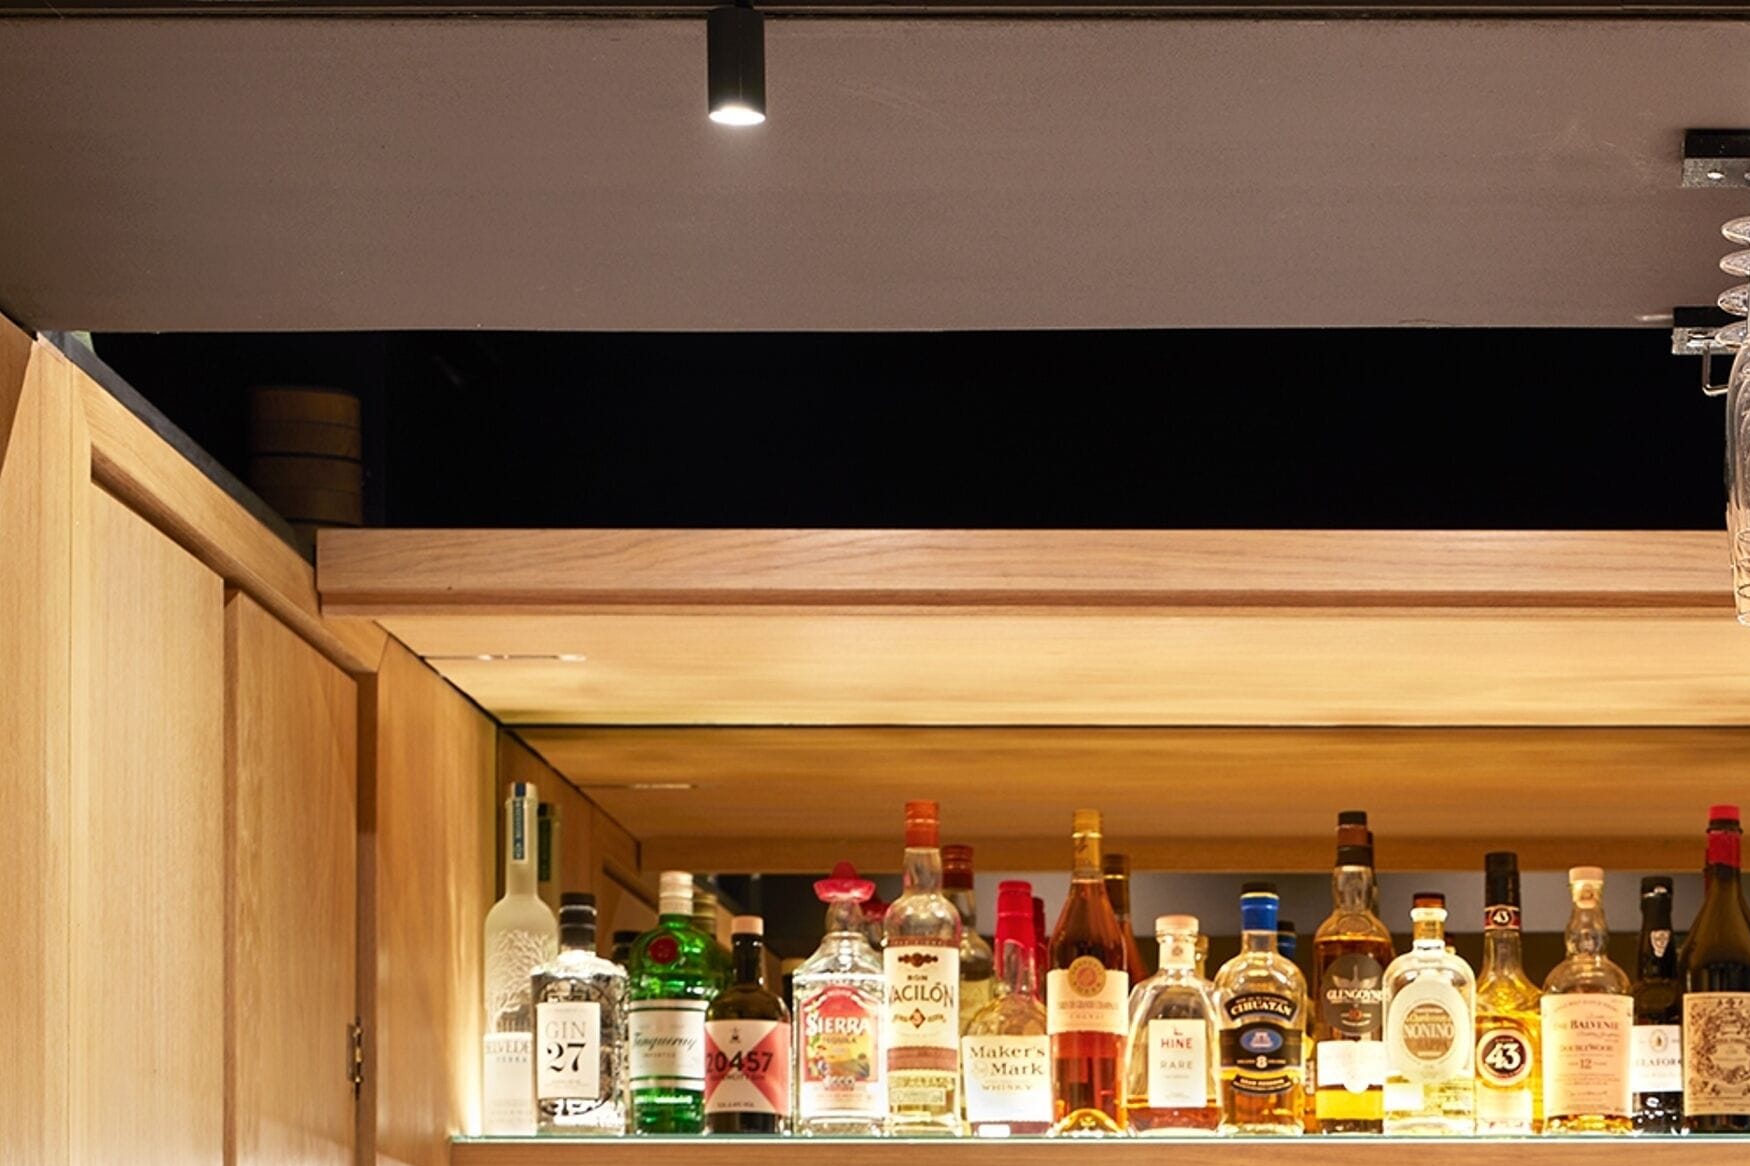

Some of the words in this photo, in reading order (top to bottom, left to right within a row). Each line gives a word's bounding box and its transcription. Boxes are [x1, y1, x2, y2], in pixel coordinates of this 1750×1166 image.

[1494, 911, 1509, 923] 43
[545, 1021, 587, 1040] GIN
[806, 1012, 872, 1036] SIERRA
[1403, 1023, 1454, 1039] NONINO
[1160, 1037, 1192, 1049] HINE
[546, 1042, 586, 1072] 27
[970, 1046, 1046, 1059] Maker's
[1485, 1043, 1521, 1070] 43
[990, 1062, 1043, 1076] Mark
[1160, 1060, 1193, 1070] RARE
[1256, 1055, 1268, 1069] 8
